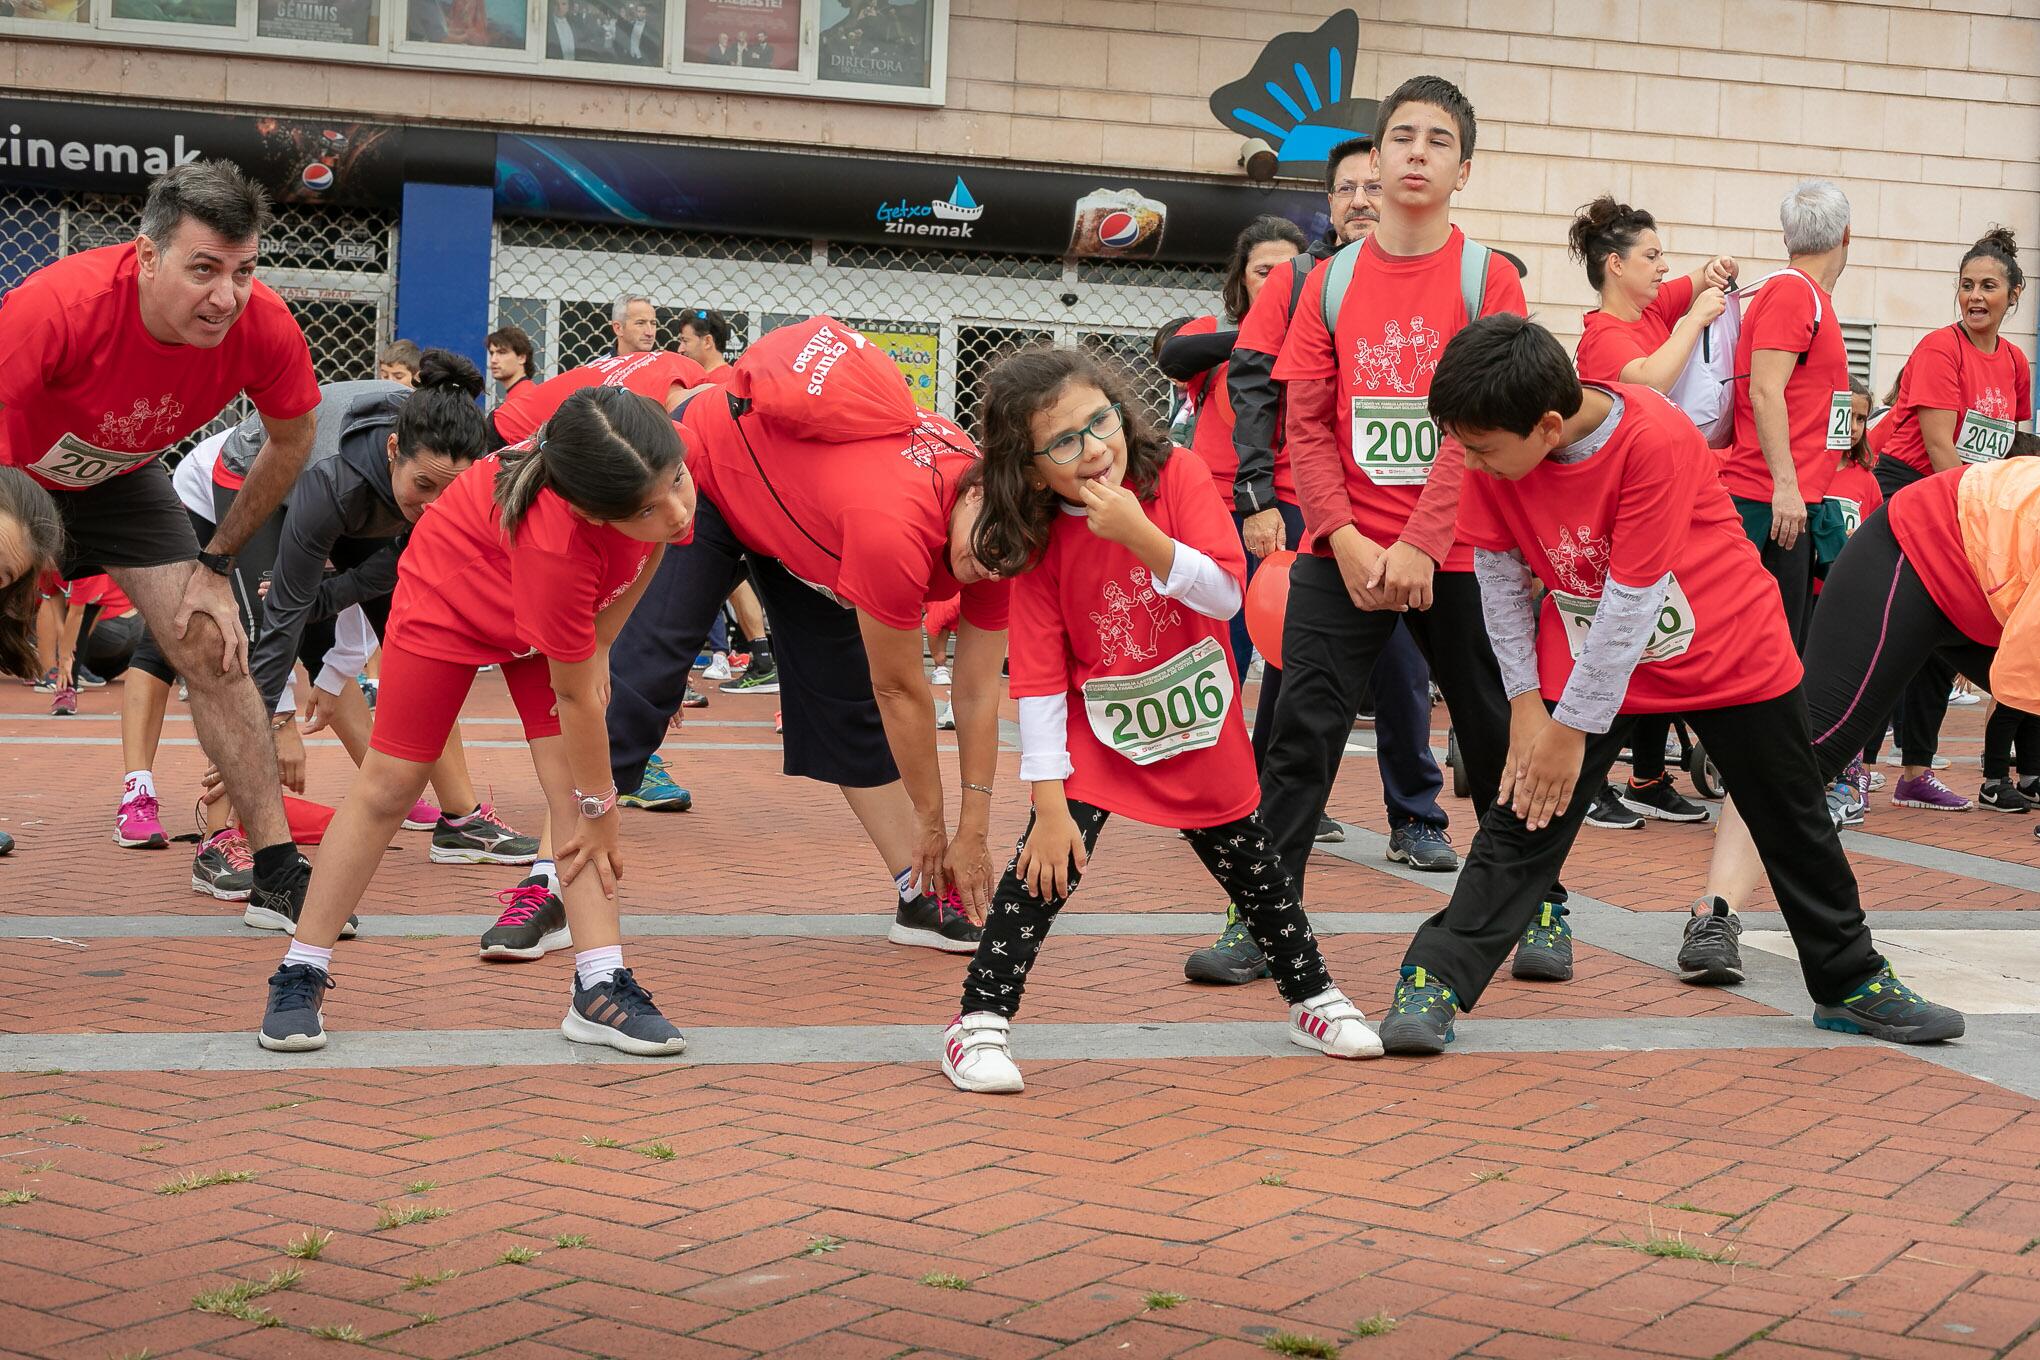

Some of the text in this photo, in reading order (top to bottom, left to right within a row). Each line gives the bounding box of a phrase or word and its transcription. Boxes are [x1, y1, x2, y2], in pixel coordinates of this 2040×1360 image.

[831, 55, 903, 72] DIRECTORA
[0, 124, 201, 175] inemak
[877, 199, 931, 221] Getxo
[885, 218, 974, 238] zinemak
[792, 325, 838, 374] bilbao
[807, 340, 849, 396] eguros
[1963, 425, 2009, 458] 2040
[1104, 670, 1224, 745] 2006
